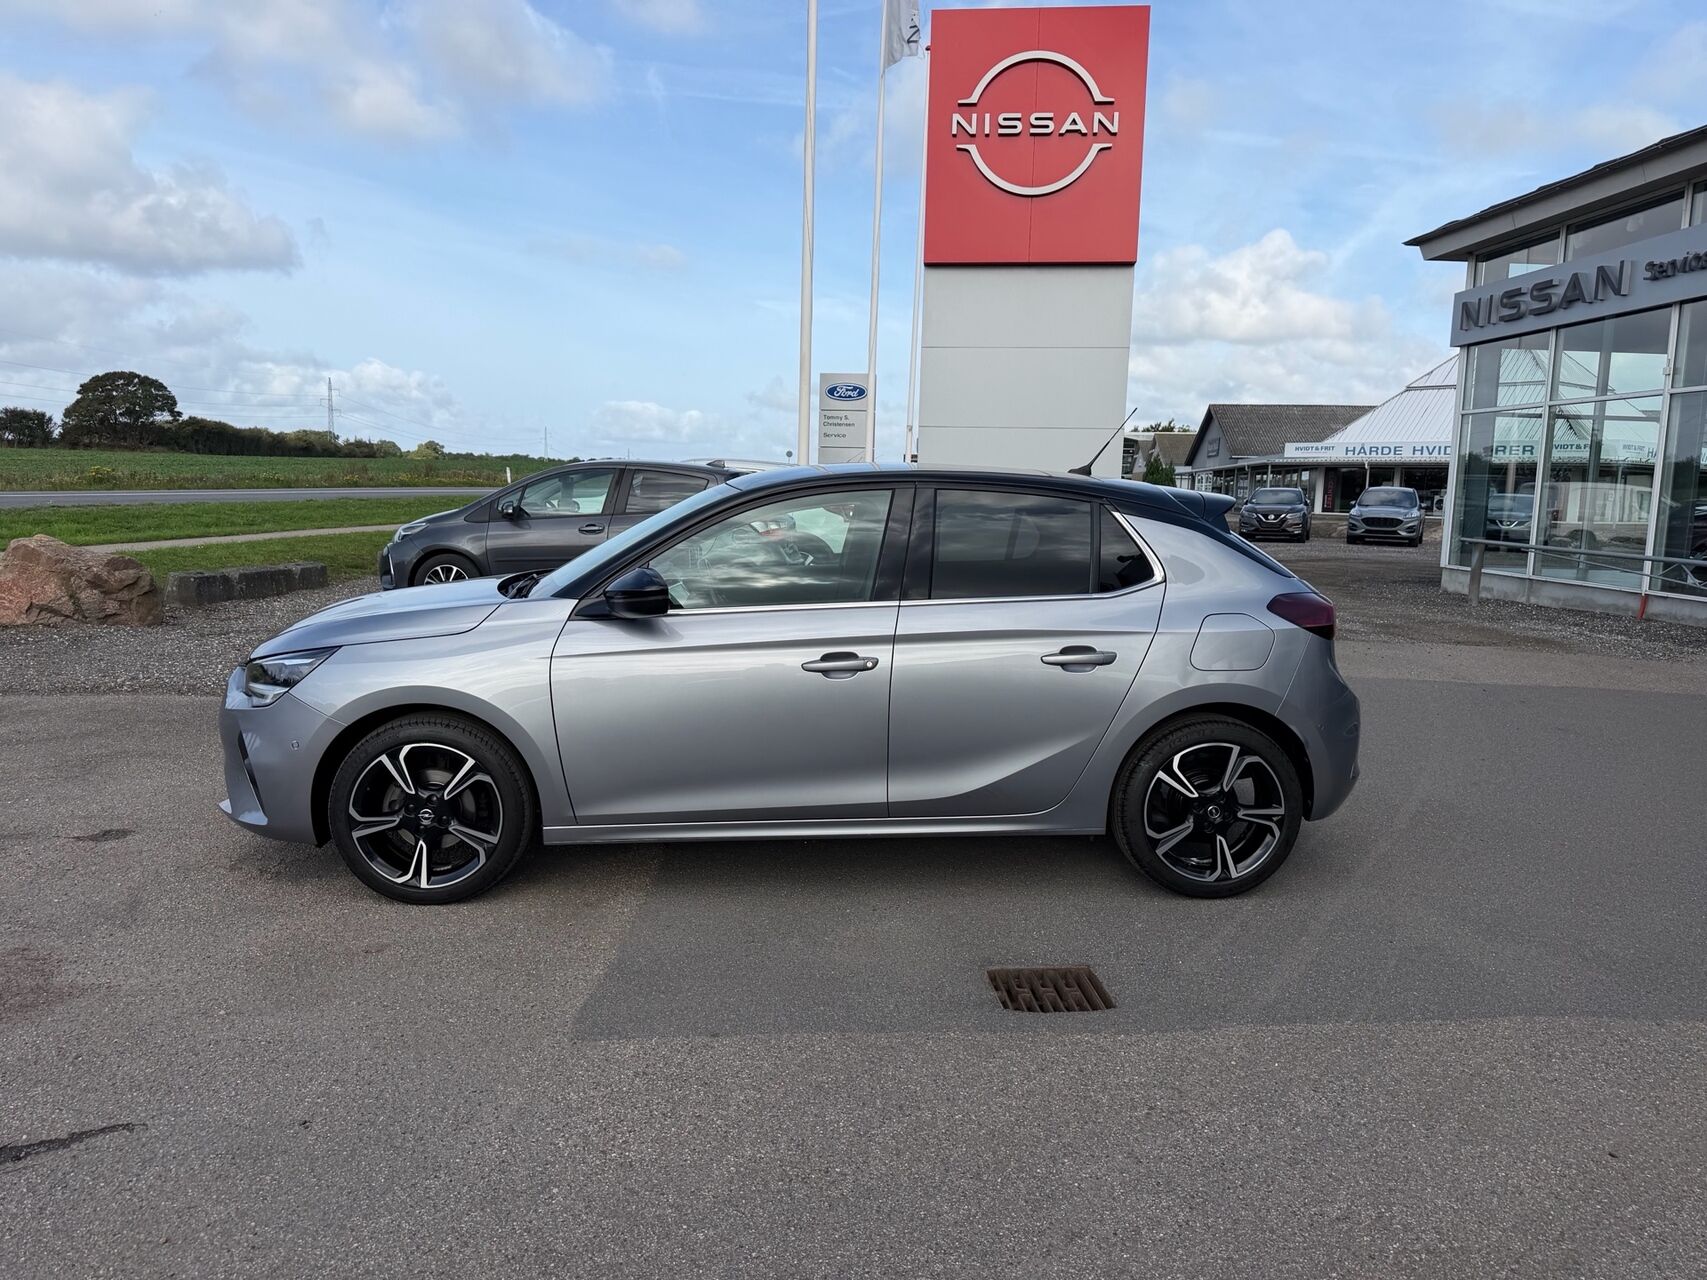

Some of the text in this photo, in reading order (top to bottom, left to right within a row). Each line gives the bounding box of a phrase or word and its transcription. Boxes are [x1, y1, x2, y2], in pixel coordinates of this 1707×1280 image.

[951, 111, 1120, 137] NISSAN
[1459, 259, 1632, 332] NISSAN
[833, 385, 860, 398] Ford
[823, 414, 843, 422] Tommy
[1345, 443, 1403, 456] HÅRDE
